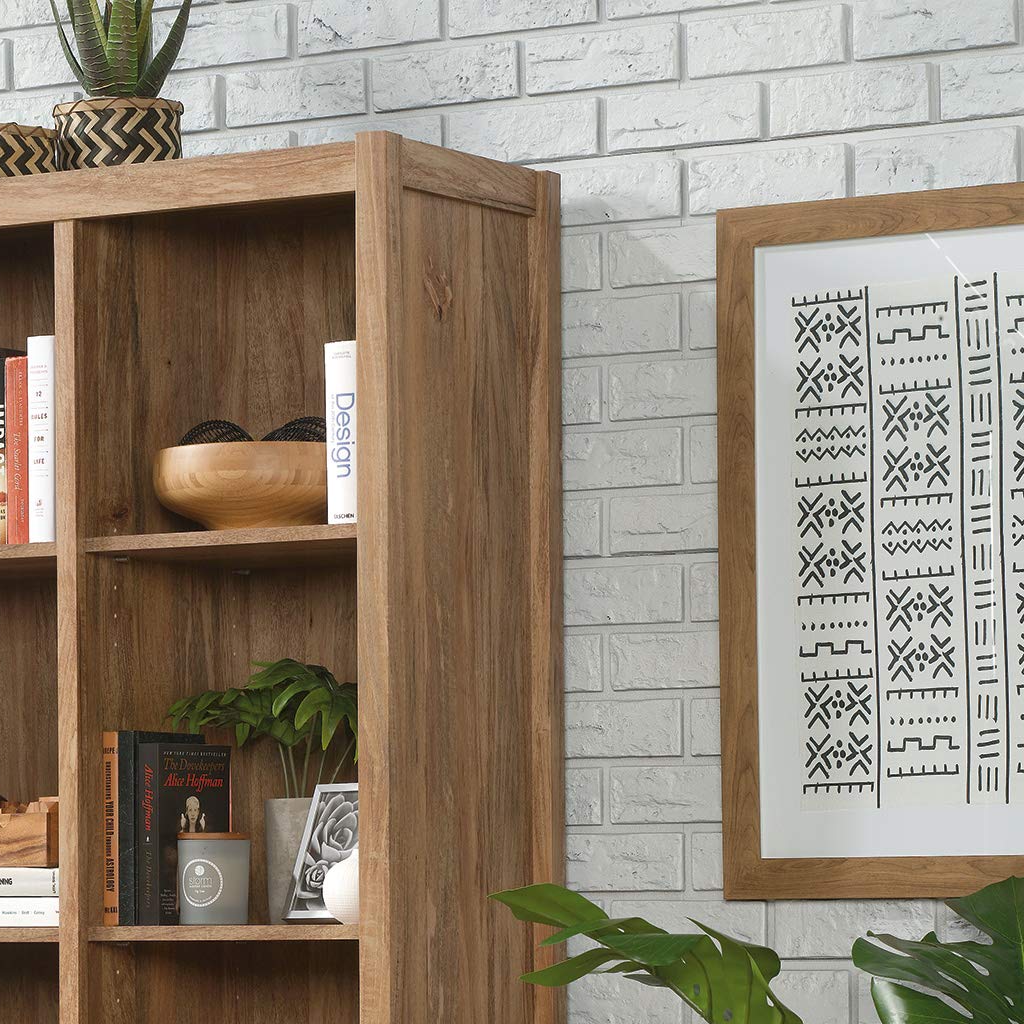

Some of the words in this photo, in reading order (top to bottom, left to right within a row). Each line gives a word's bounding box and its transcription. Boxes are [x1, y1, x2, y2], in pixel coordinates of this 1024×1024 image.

[332, 393, 355, 478] Design
[144, 764, 154, 787] Alice
[164, 758, 178, 771] The
[179, 758, 225, 775] Dovekeepers
[164, 773, 185, 787] Alice
[186, 773, 224, 793] Hoffman
[106, 801, 114, 817] YOUR
[142, 788, 154, 831] Hoffman
[106, 818, 115, 836] CHILD
[106, 858, 115, 893] ASTROLOGY
